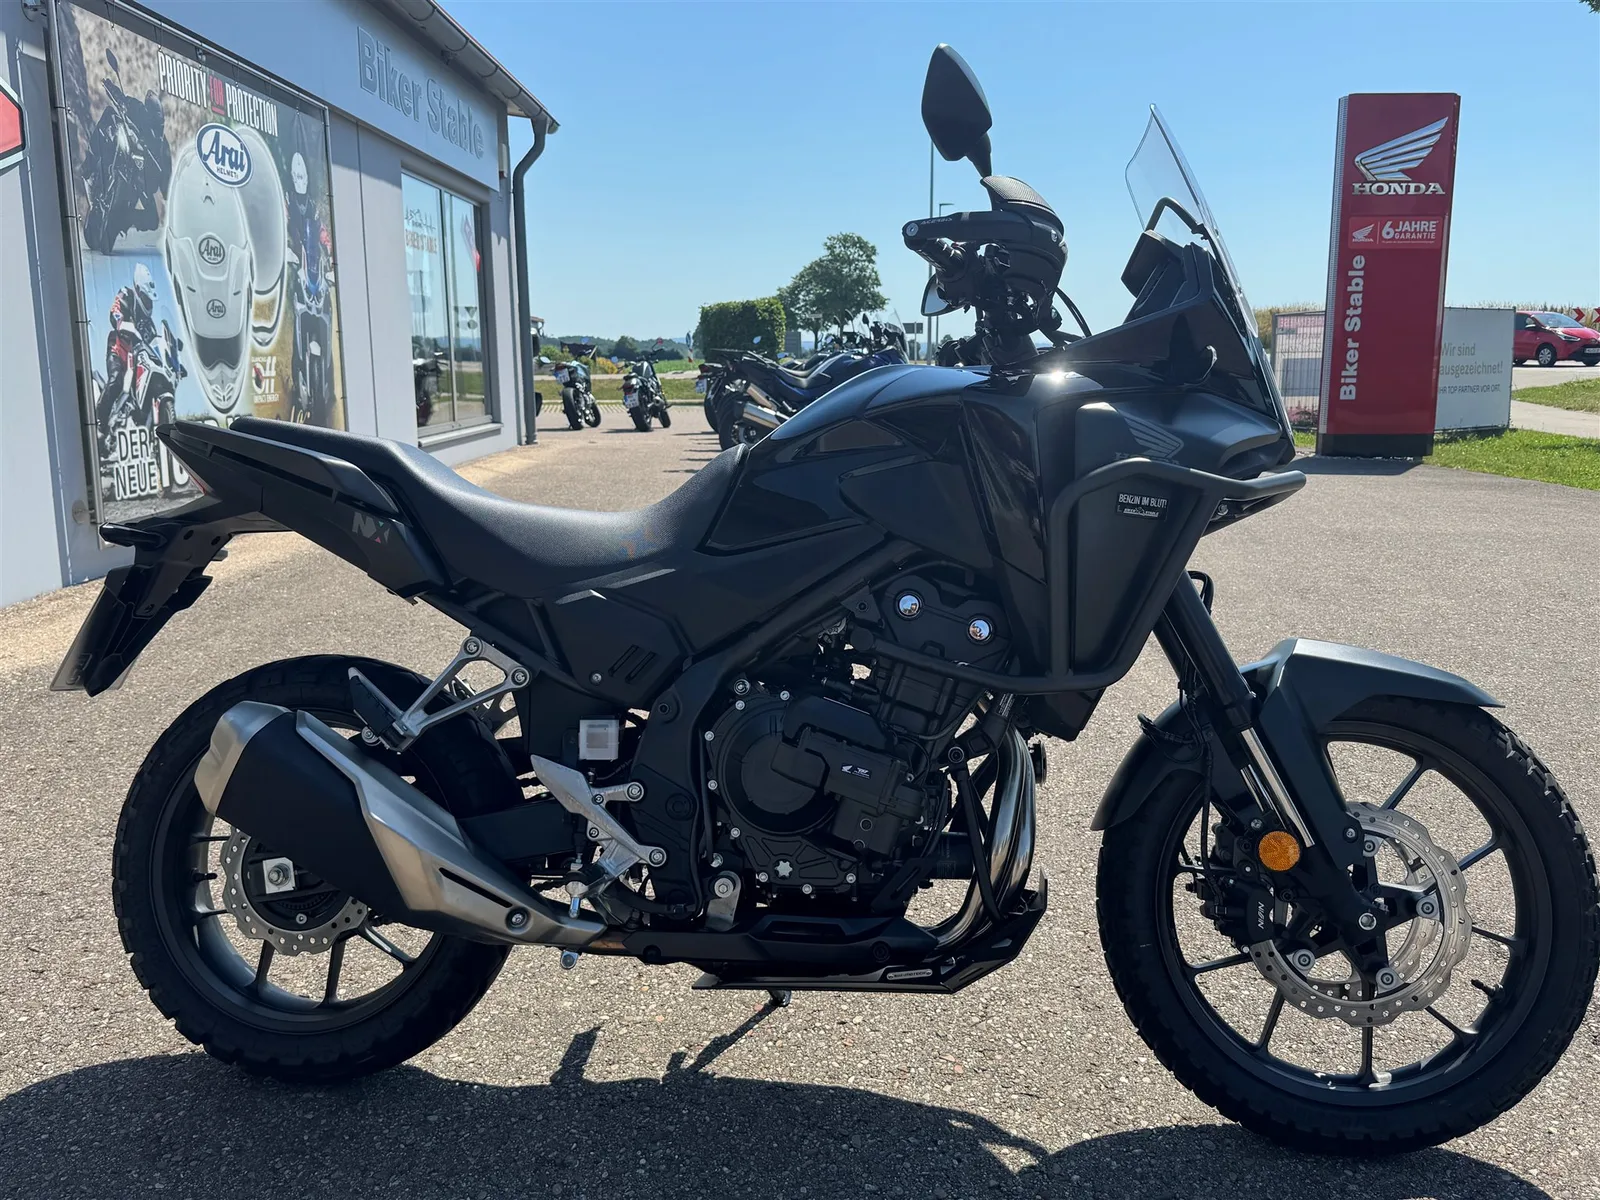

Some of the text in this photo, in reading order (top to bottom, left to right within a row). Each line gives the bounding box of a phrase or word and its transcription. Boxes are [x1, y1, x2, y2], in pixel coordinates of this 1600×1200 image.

[157, 51, 278, 137] PRIORITY FOR PROTECTION
[357, 26, 484, 160] Biker Stable
[202, 130, 246, 172] Arai
[1352, 182, 1446, 195] HONDA
[1381, 220, 1395, 240] 6
[1395, 232, 1436, 240] GARANTIE
[201, 239, 223, 259] Arai
[1339, 254, 1366, 401] Biker Stable
[1441, 342, 1476, 357] Wir sind
[1439, 361, 1503, 378] ausgezeichnet!
[118, 428, 149, 462] DER
[115, 460, 157, 498] NEUE
[1119, 494, 1167, 508] BENZIN IM BLUT!
